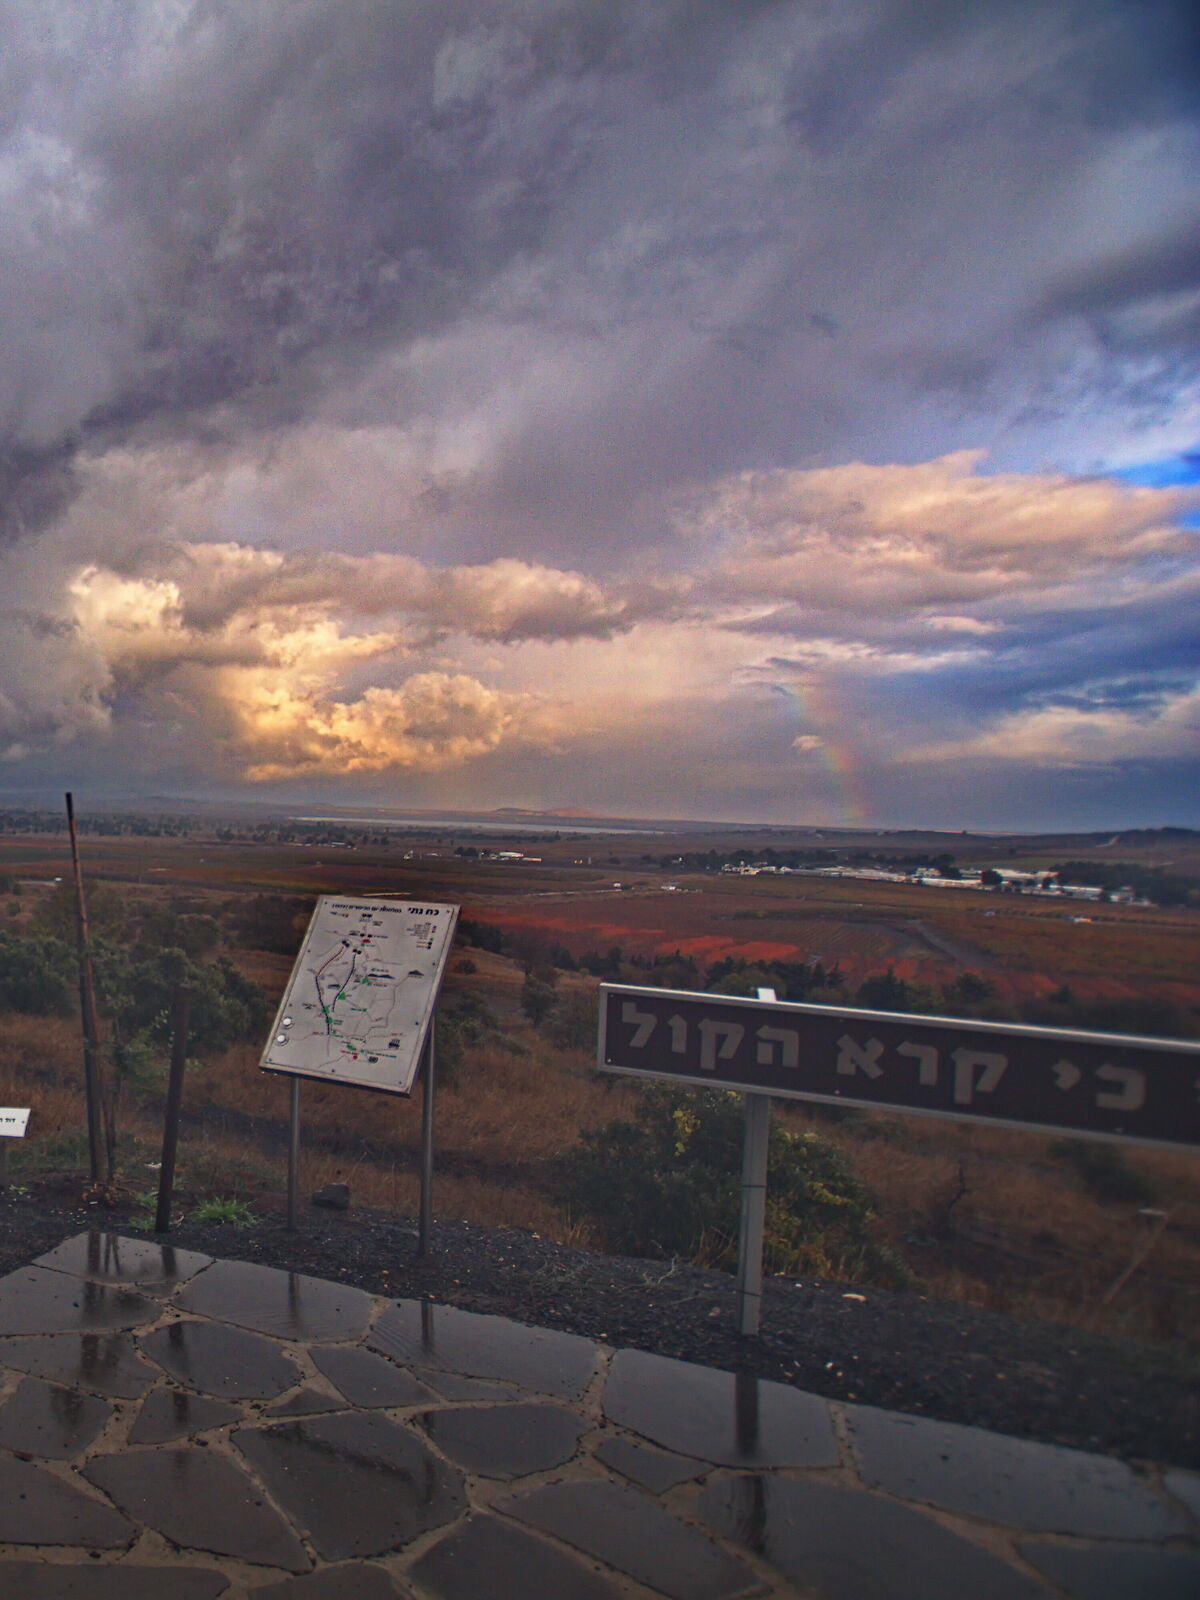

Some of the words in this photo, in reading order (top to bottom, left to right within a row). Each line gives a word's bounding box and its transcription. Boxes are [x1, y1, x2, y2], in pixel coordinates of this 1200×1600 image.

[621, 1001, 800, 1072] הקול
[836, 1034, 1009, 1105] קרא
[1051, 1059, 1147, 1112] כי
